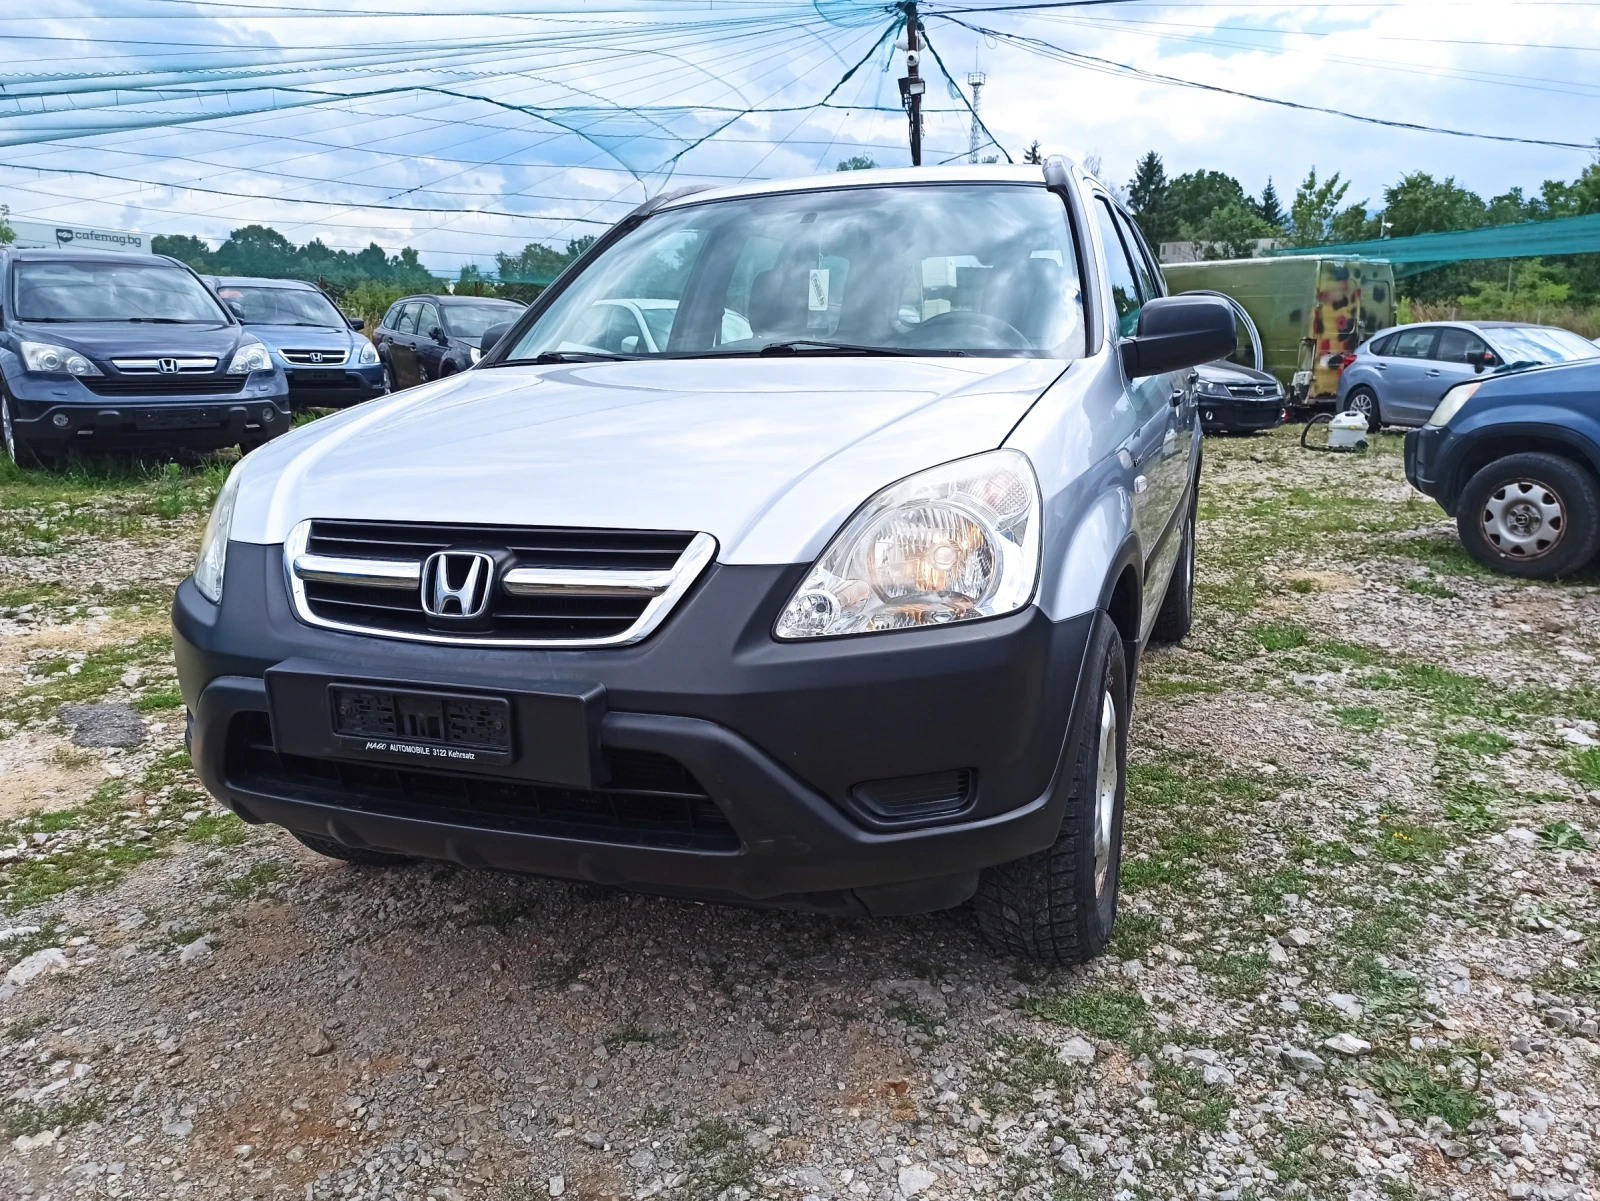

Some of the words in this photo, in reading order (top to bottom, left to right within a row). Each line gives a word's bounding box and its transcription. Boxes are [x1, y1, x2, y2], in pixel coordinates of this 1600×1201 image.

[389, 743, 431, 755] AUTOMOBILE
[432, 748, 447, 757] 3122
[448, 749, 476, 760] Kehrsatz
